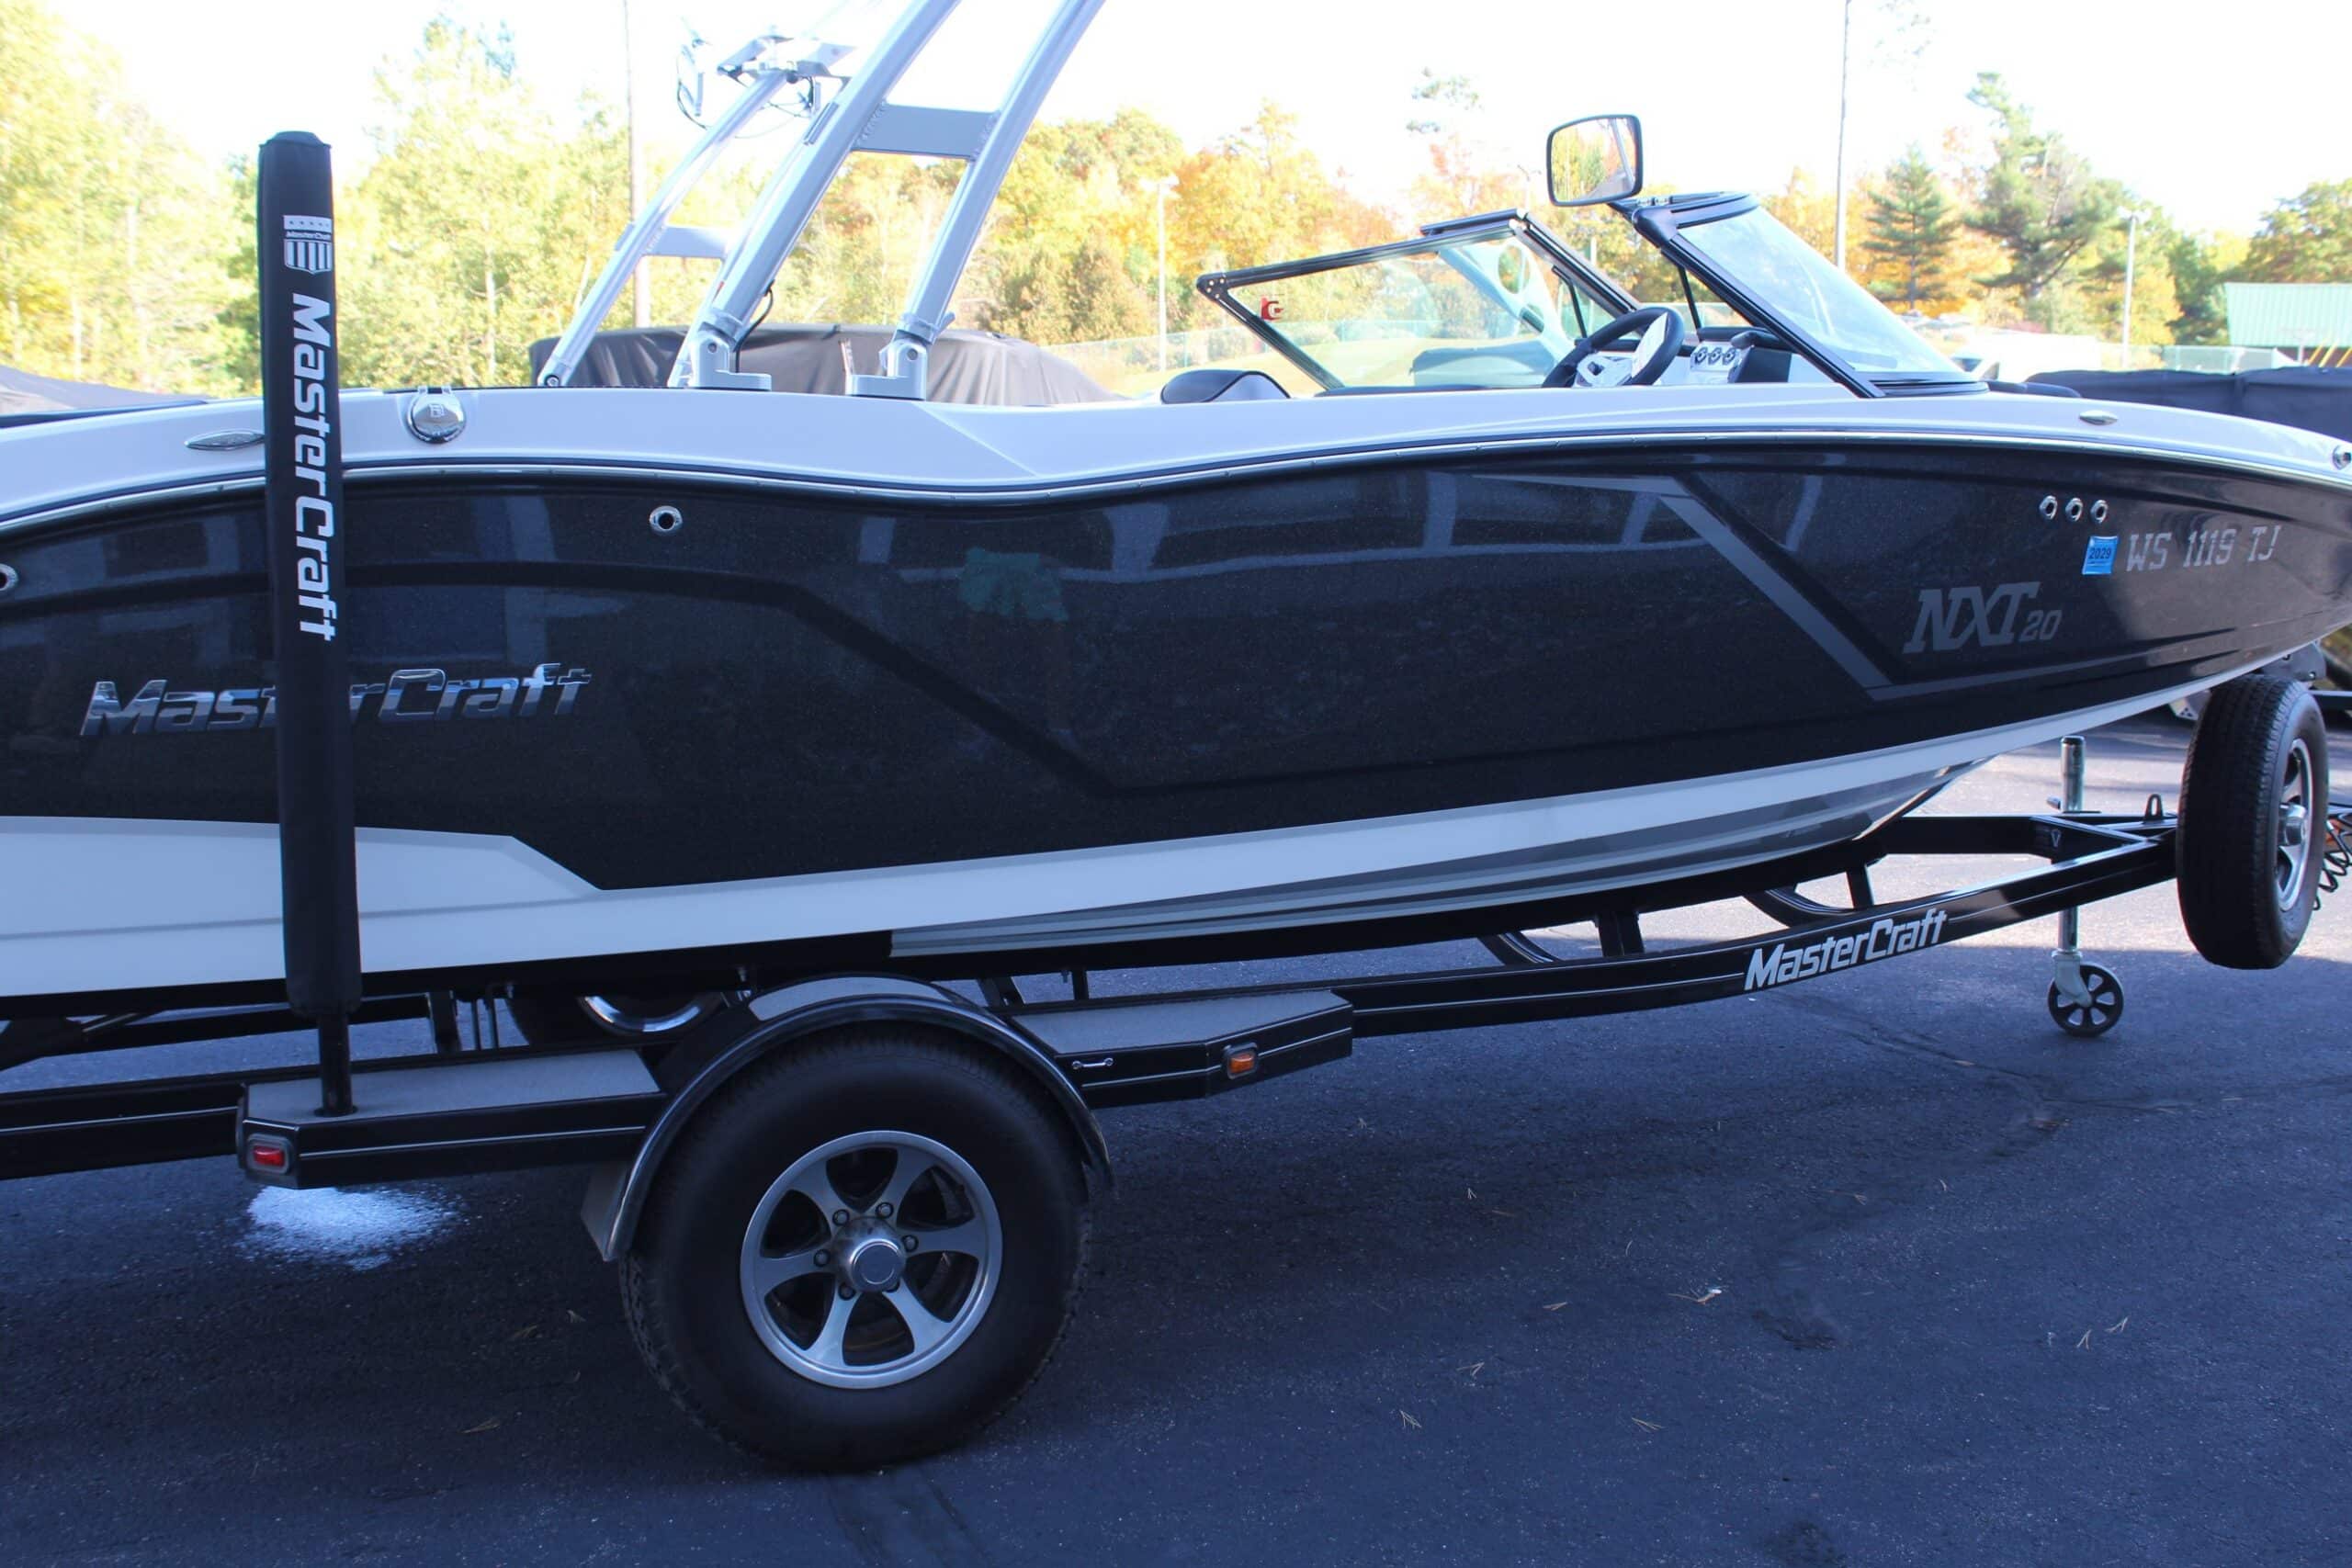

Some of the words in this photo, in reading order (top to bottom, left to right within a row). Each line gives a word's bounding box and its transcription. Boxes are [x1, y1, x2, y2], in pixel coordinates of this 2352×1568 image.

[292, 292, 337, 641] MasterCraft
[2126, 532, 2173, 571] WS
[2248, 525, 2281, 562] TJ
[1903, 581, 2041, 654] NXT
[2018, 609, 2063, 641] 20
[80, 662, 593, 736] MasrCraft
[1744, 908, 1948, 991] MasterCraft
